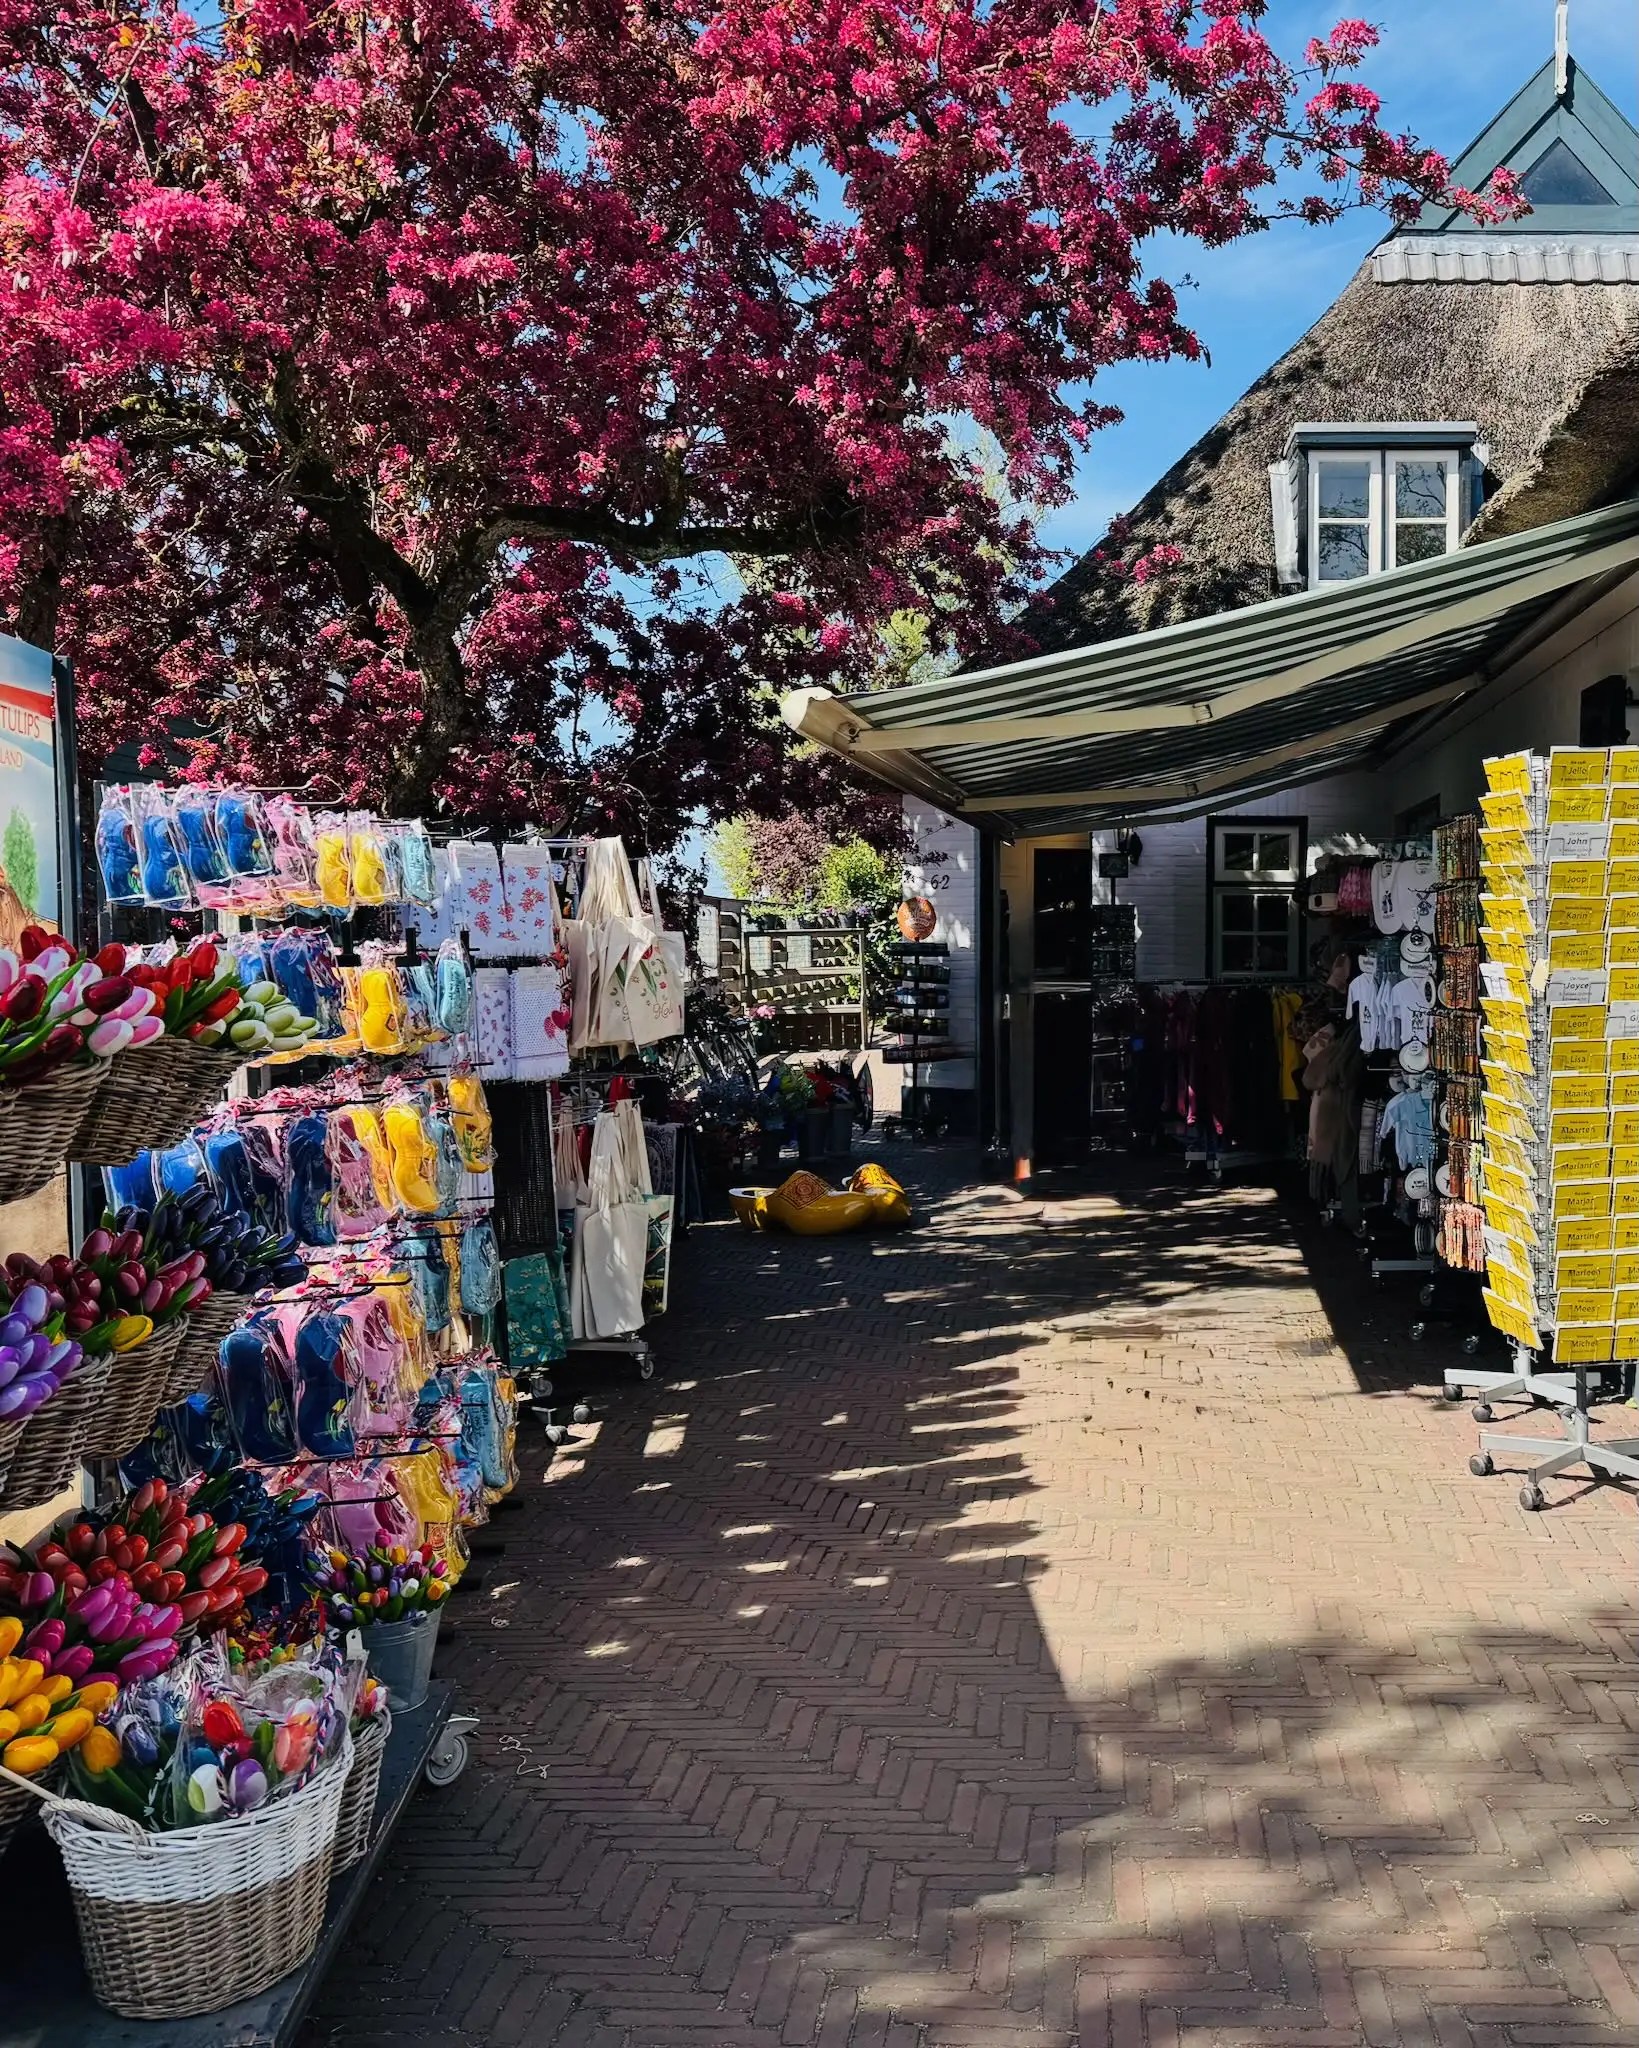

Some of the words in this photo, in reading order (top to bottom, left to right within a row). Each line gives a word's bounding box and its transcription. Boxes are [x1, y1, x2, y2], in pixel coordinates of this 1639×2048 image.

[1, 705, 40, 738] TULIPS
[1566, 911, 1588, 919] Karin
[1565, 982, 1590, 990] Joyce
[1567, 1020, 1588, 1028] Leon
[1570, 1055, 1586, 1063] Lisa
